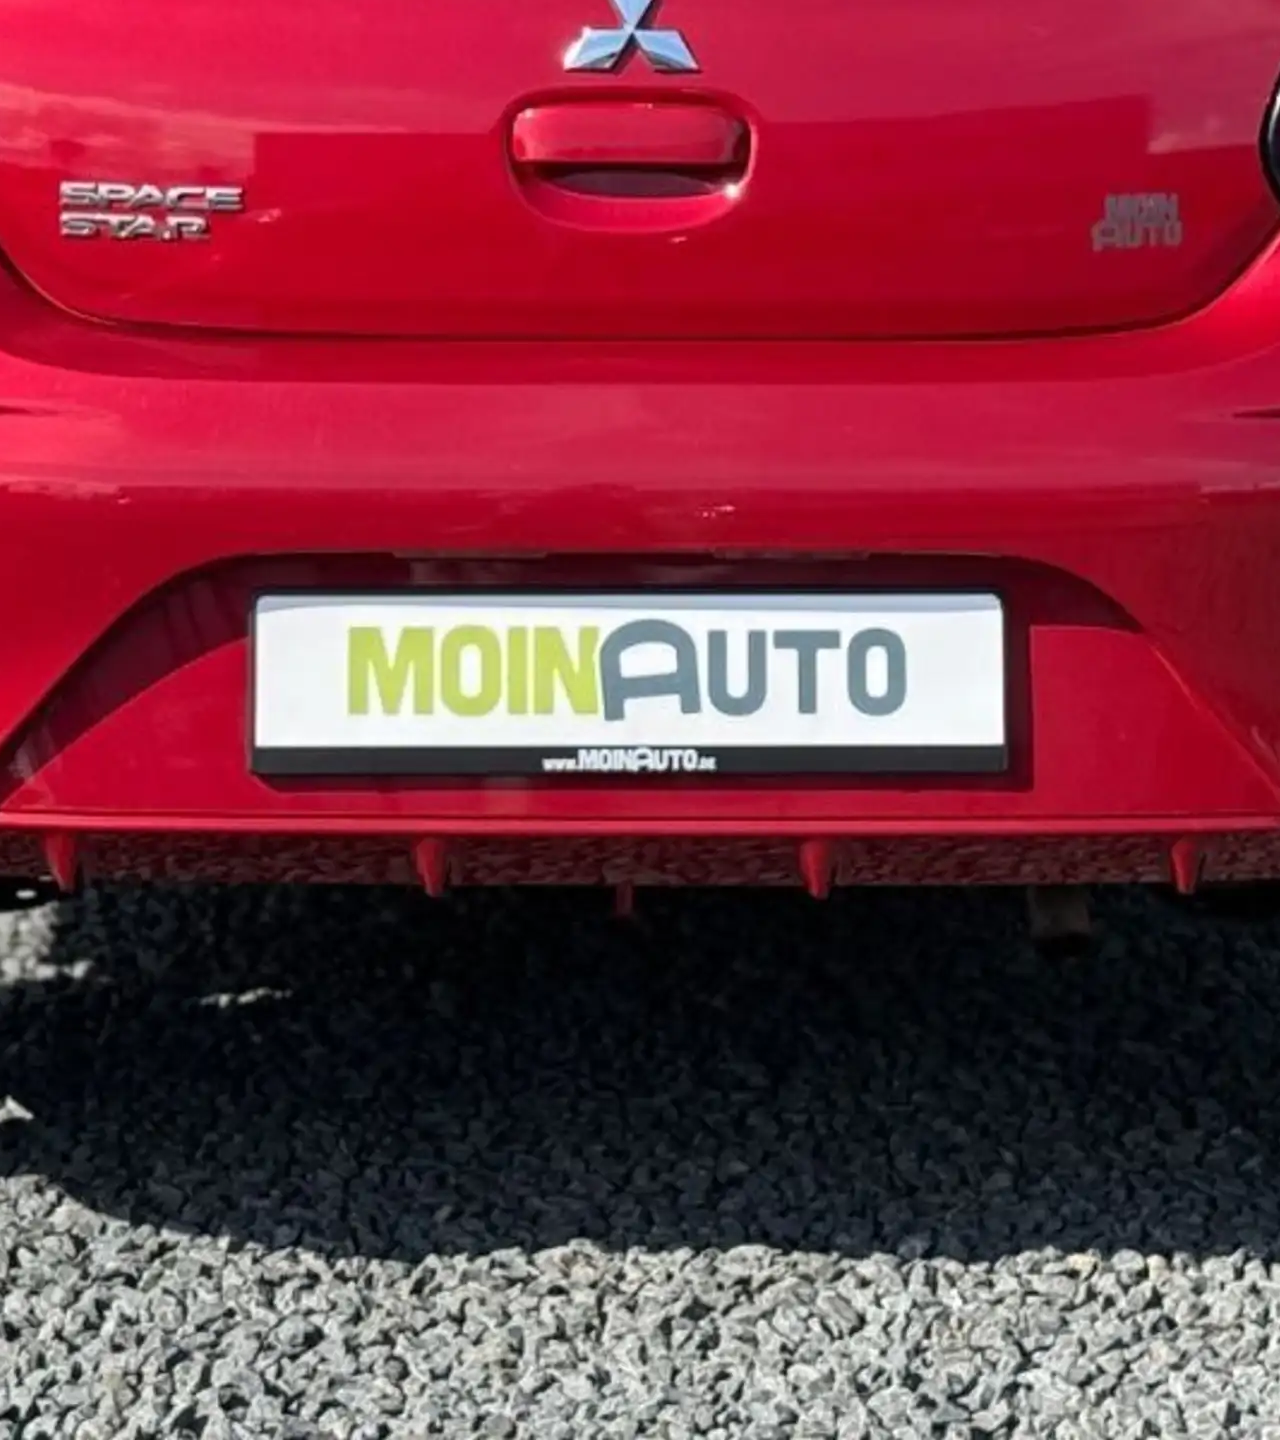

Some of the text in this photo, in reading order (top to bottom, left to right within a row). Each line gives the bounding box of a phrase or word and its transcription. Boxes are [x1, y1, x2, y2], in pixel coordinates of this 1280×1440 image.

[60, 181, 243, 210] SPACE
[60, 212, 210, 239] STAR
[348, 618, 907, 721] MOINAUTO
